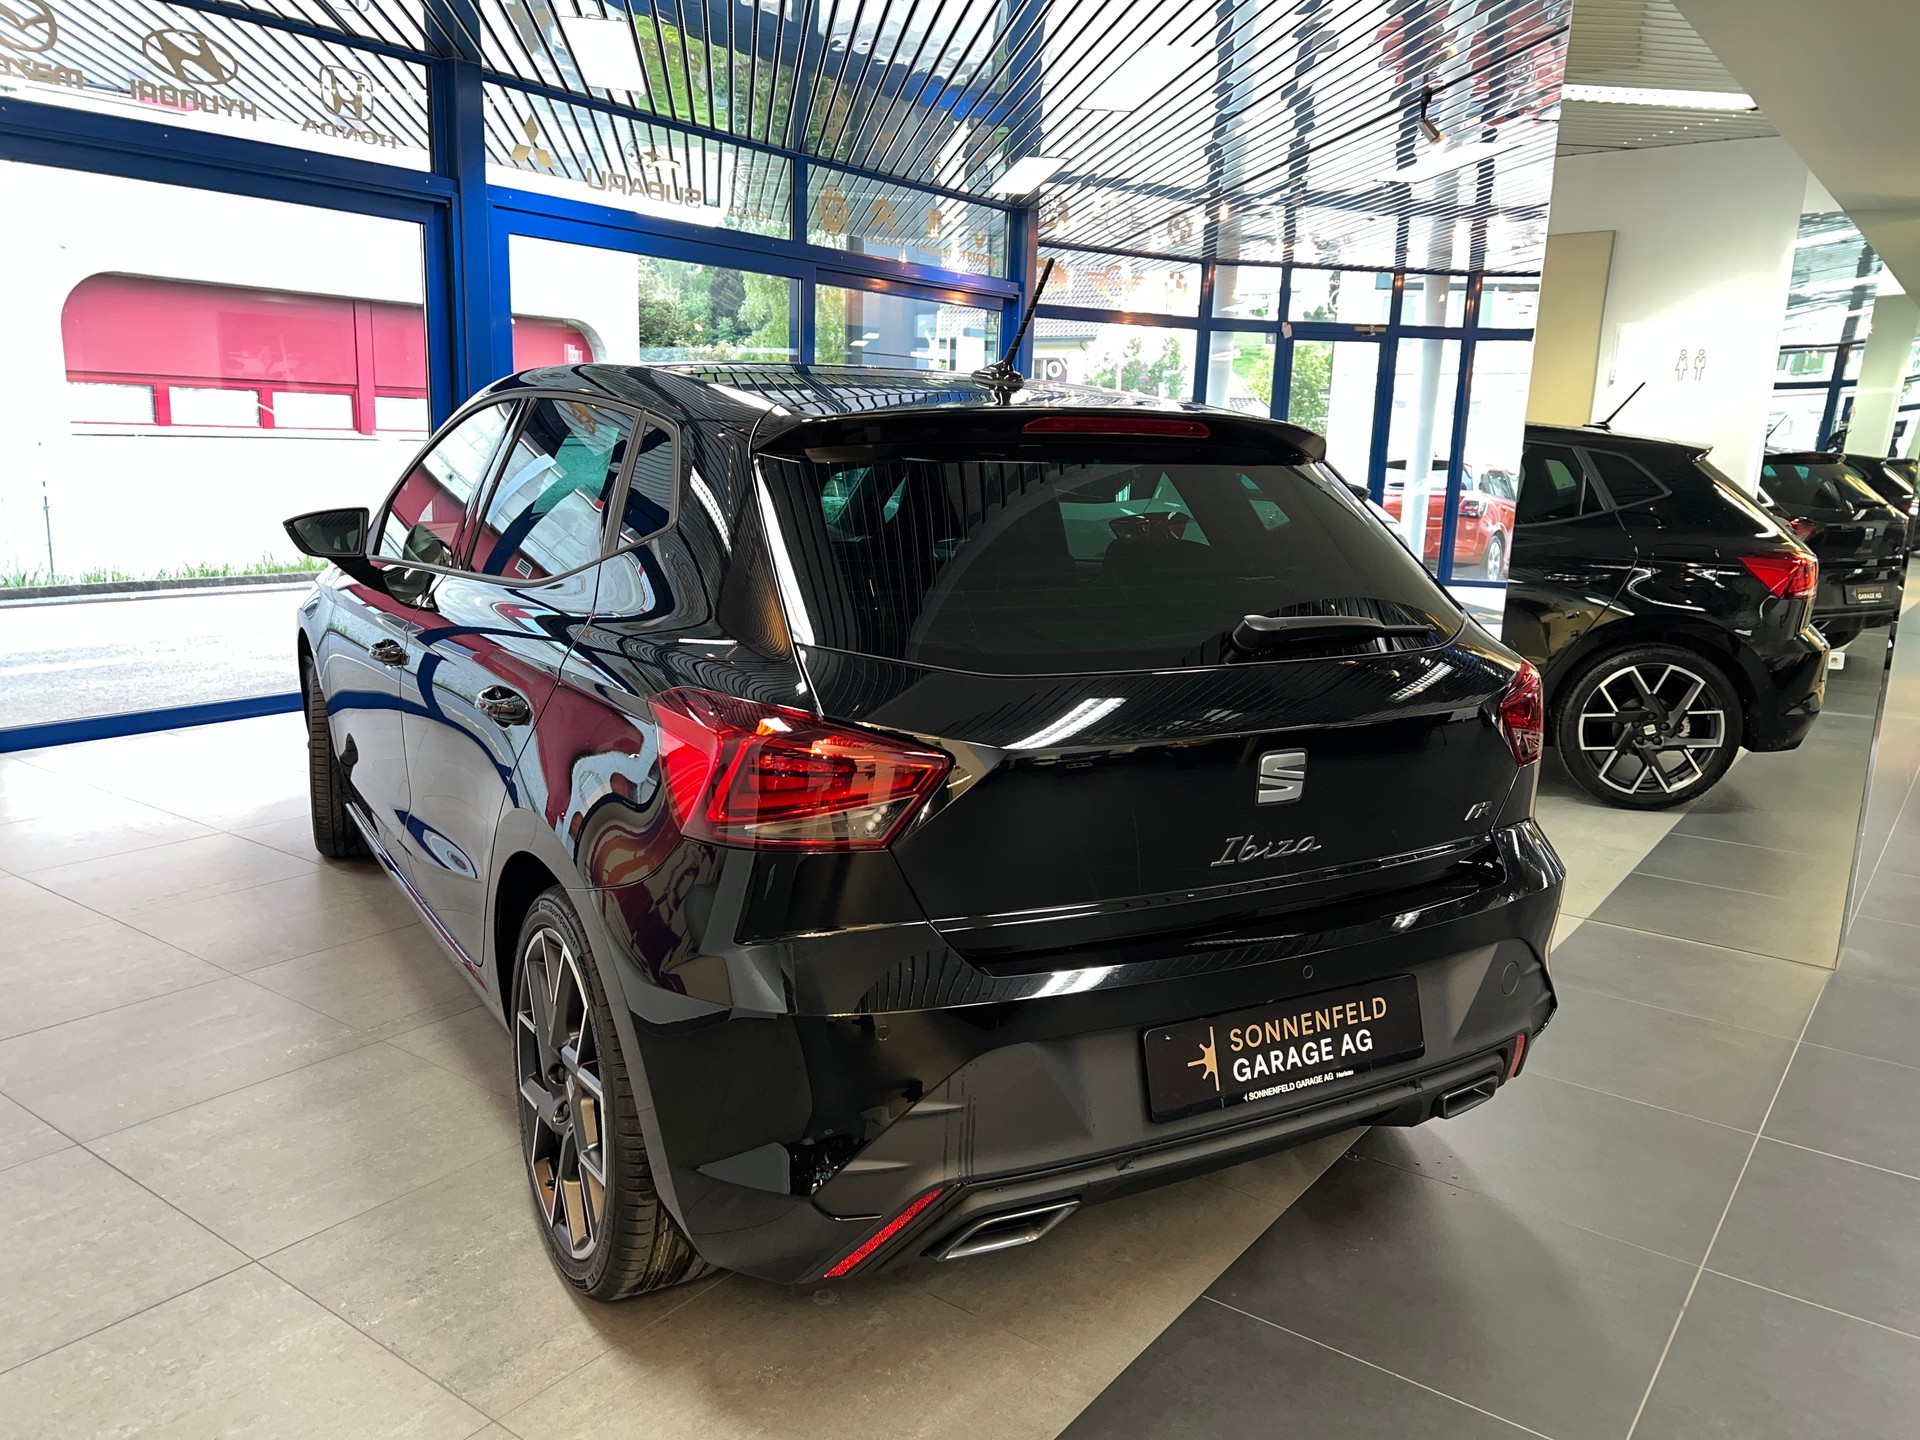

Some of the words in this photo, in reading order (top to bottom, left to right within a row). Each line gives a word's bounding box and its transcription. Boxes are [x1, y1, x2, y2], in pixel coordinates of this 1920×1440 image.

[1210, 834, 1322, 867] Ibiza
[1229, 996, 1387, 1052] SONNENFELD
[1233, 1037, 1334, 1083] GARAGE
[1341, 1028, 1373, 1057] AG
[1248, 1082, 1296, 1101] SONNENFELD
[1295, 1074, 1324, 1090] GARAGE
[1323, 1071, 1334, 1082] AG
